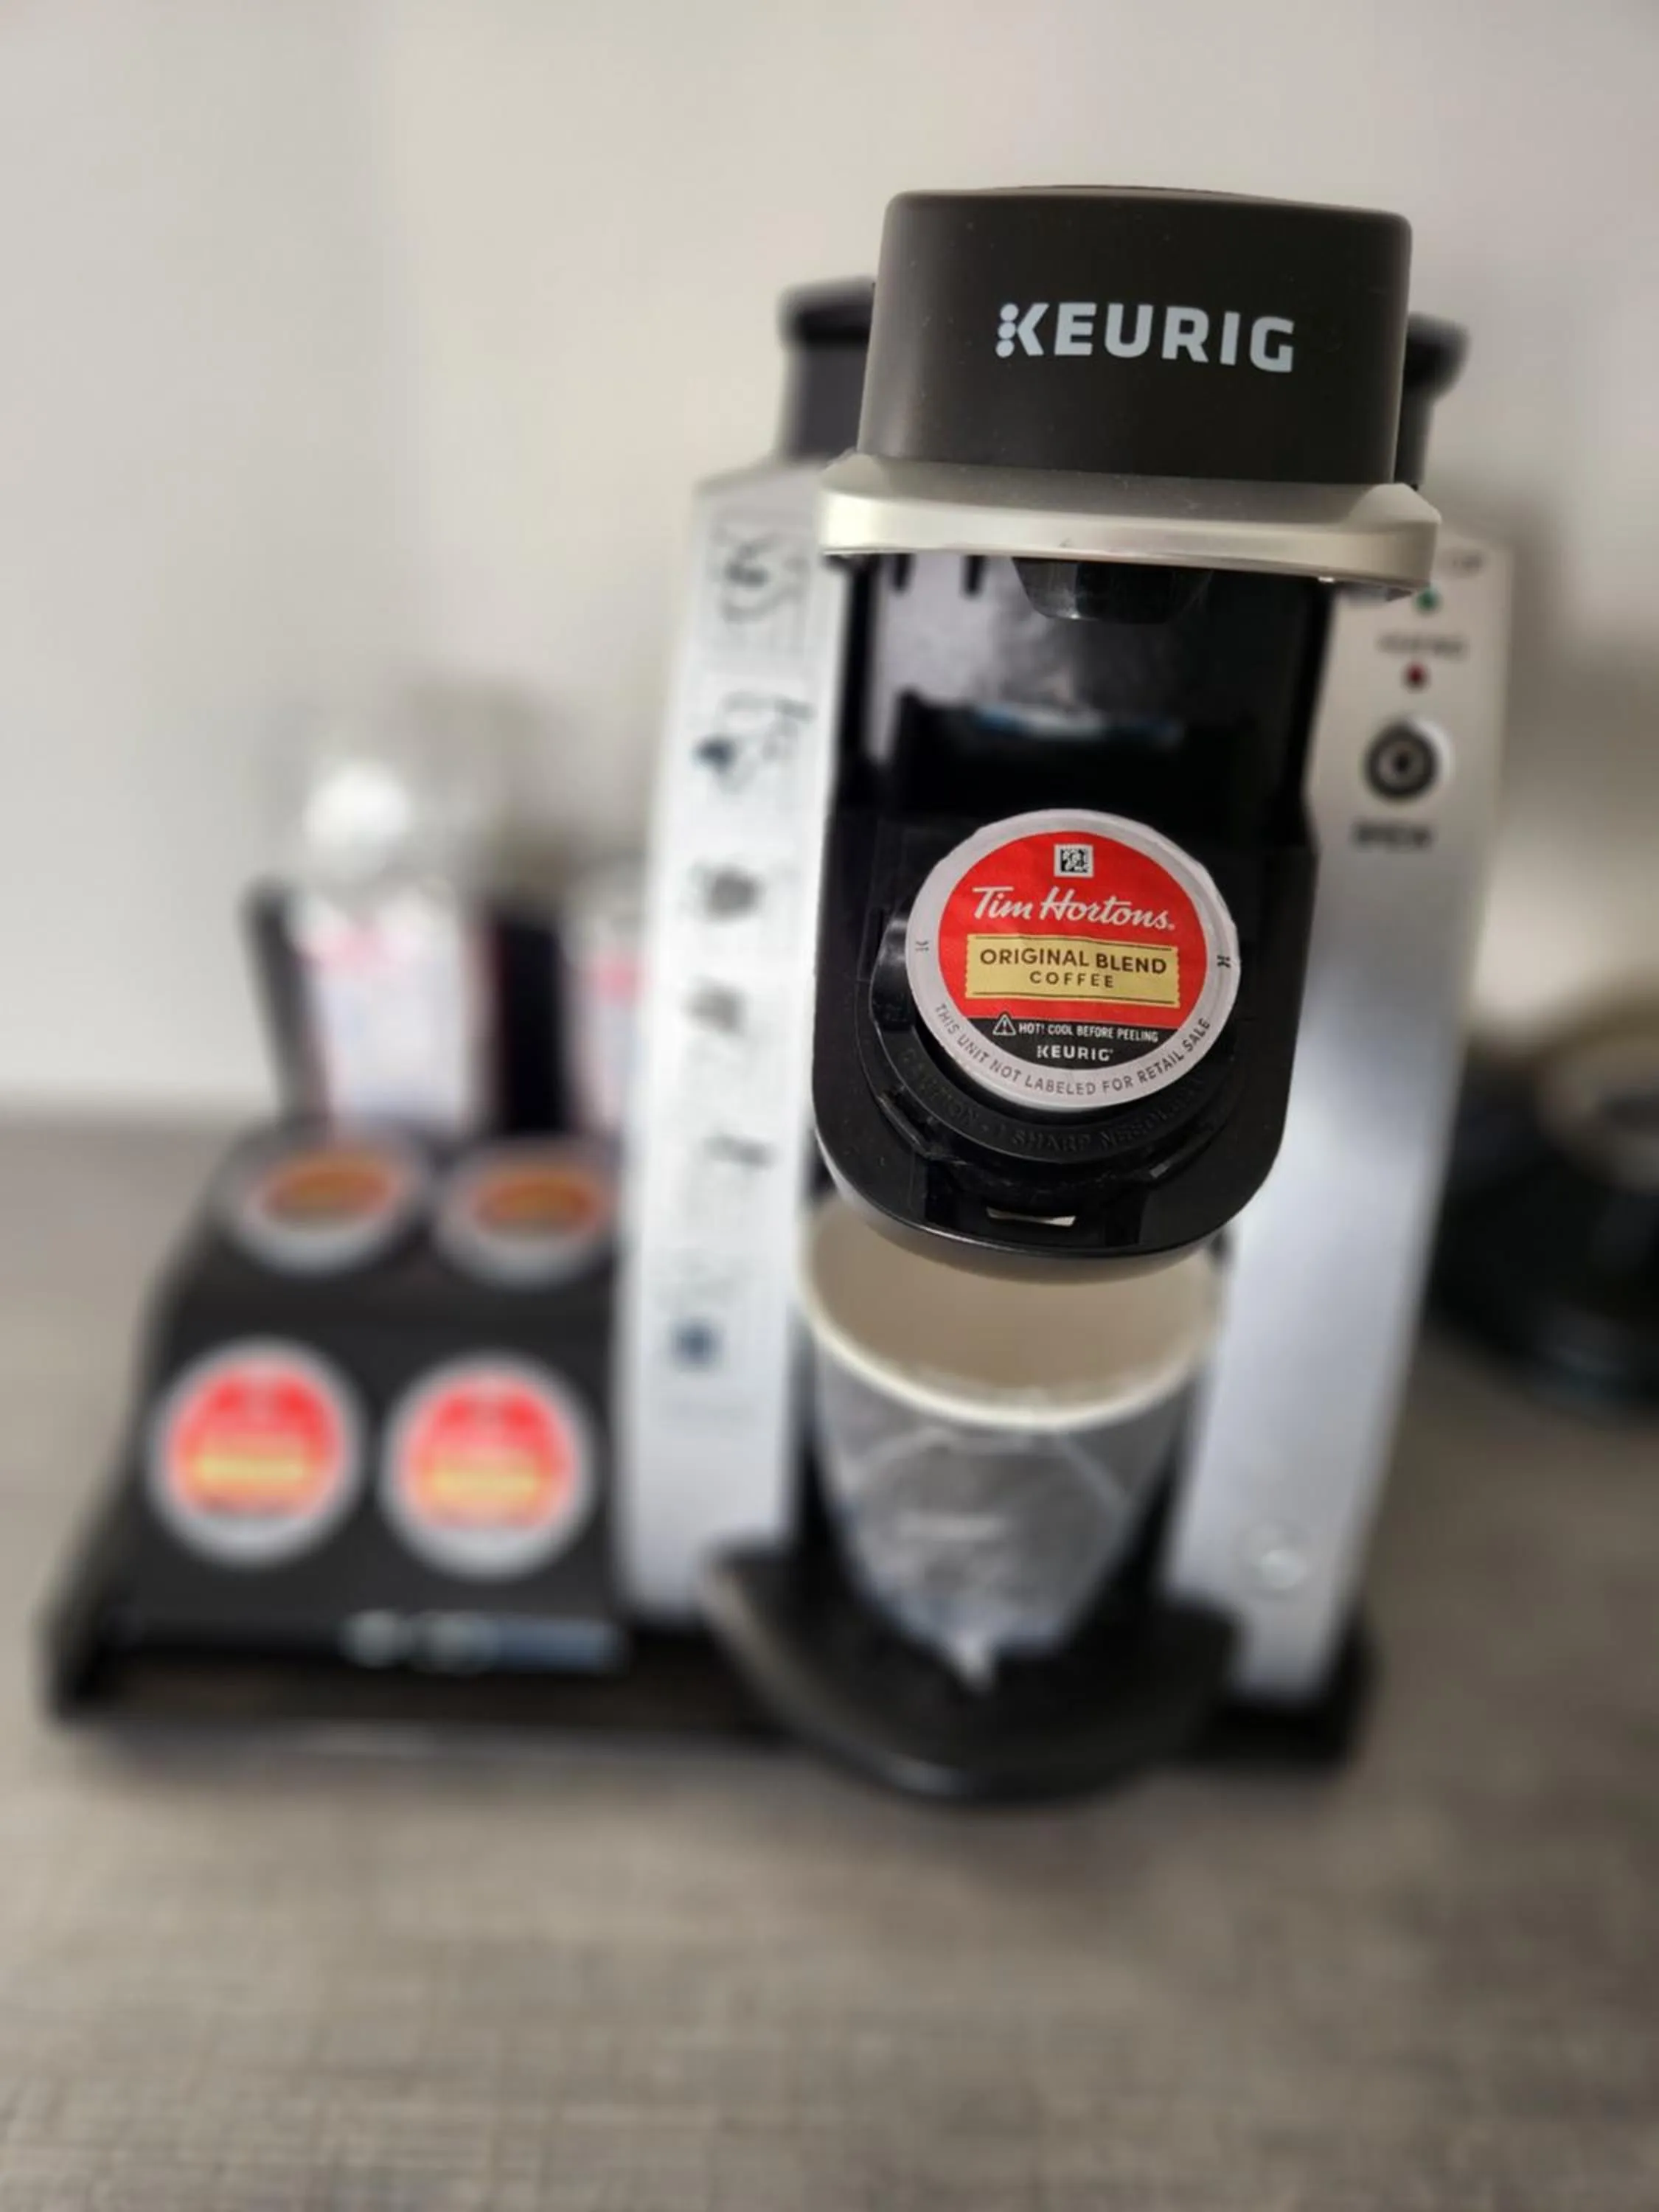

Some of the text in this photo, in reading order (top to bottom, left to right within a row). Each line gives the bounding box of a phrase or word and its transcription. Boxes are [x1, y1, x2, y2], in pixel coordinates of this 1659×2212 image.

[996, 302, 1295, 372] KEURIG
[973, 886, 1034, 920] Tim
[980, 948, 1167, 974] ORIGINAL BLEND
[1029, 971, 1114, 989] COFFEE
[1019, 1022, 1159, 1043] HOT! COOL BEFORE PEELING
[935, 1004, 1211, 1096] THIS UNIT NOT LABELED FOR RETAIL SALE
